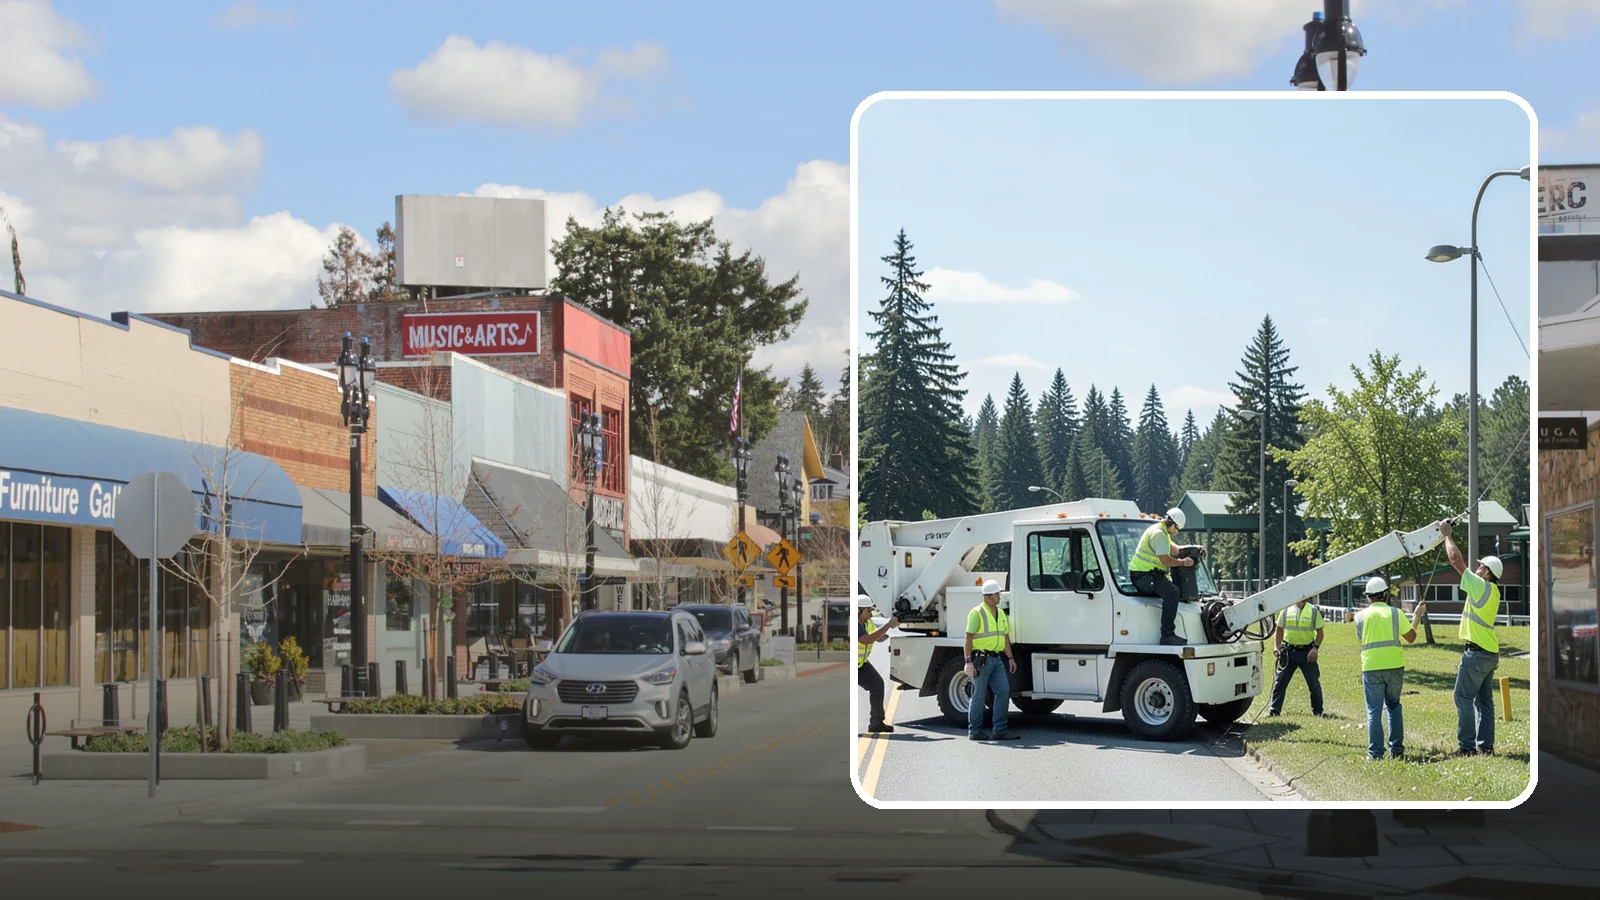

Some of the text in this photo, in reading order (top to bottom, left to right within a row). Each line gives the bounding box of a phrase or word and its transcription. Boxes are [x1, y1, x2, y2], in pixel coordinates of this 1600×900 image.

[409, 323, 520, 349] MUSIC&ARTS
[0, 471, 79, 515] Furniture
[453, 563, 479, 574] SUSHI
